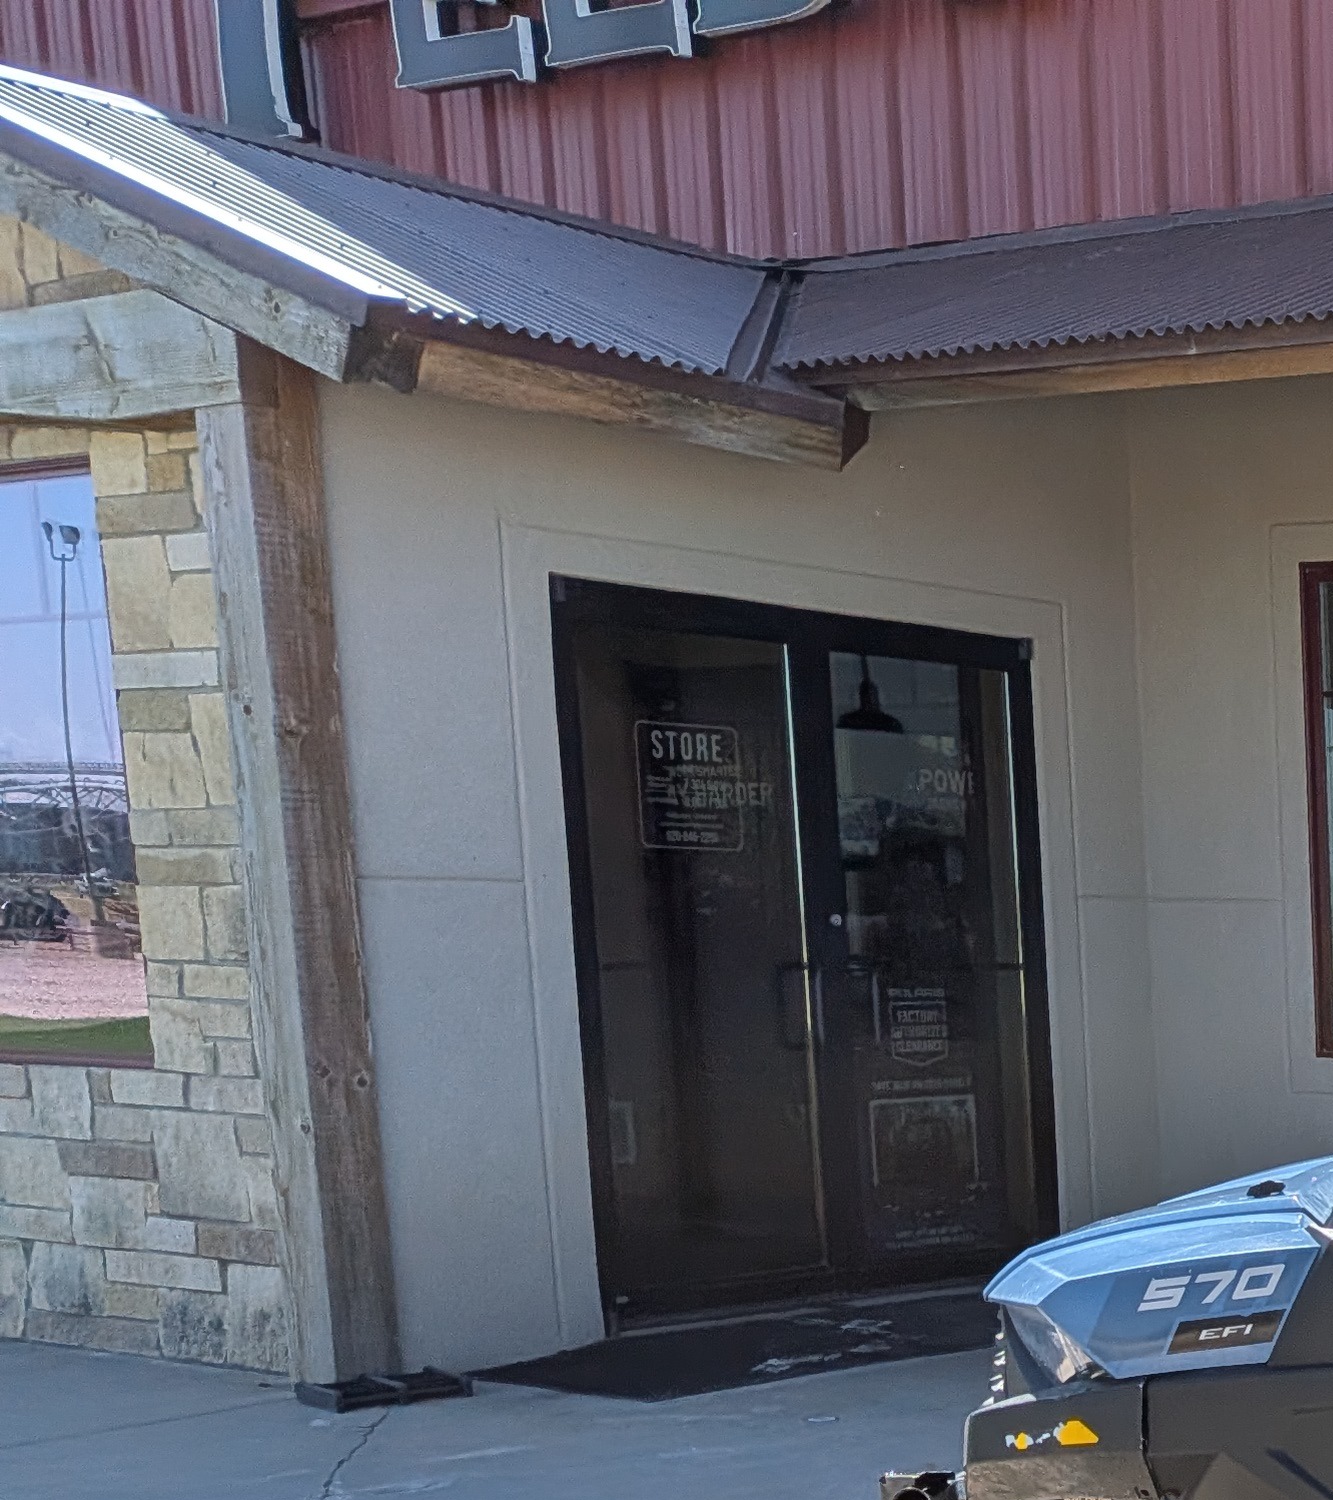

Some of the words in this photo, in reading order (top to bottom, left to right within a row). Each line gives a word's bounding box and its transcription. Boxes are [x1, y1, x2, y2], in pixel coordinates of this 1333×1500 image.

[650, 729, 724, 763] STORE
[1136, 1262, 1287, 1313] 570
[1197, 1322, 1255, 1342] EFI
